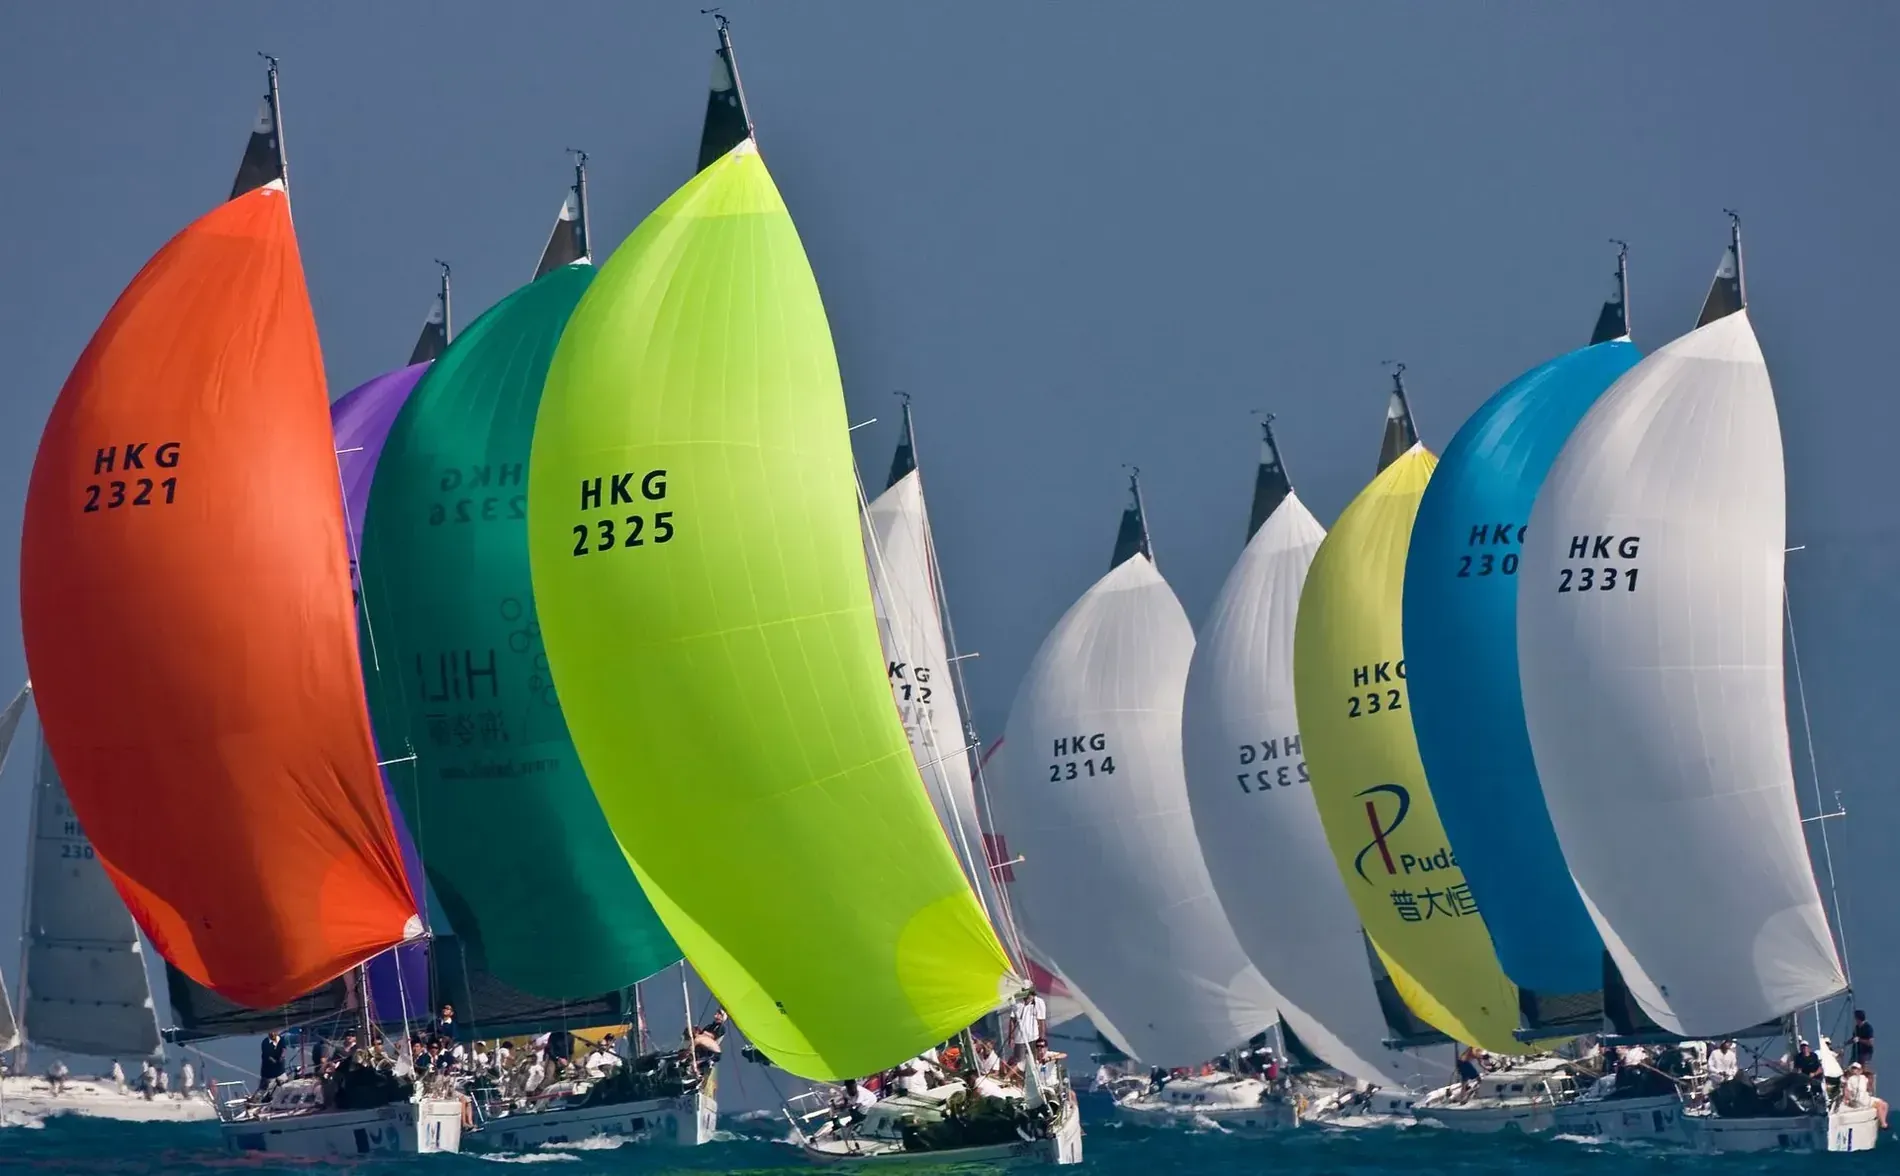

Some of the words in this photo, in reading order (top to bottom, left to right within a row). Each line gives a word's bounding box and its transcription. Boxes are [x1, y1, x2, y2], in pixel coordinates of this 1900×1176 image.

[94, 442, 181, 475] HKG
[83, 477, 177, 513] 2321
[581, 469, 667, 511] HKG
[572, 511, 675, 557] 2325
[1568, 536, 1641, 559] HKG
[1456, 553, 1519, 578] 230
[1558, 568, 1639, 593] 2331
[890, 683, 933, 704] 12
[1347, 689, 1402, 718] 232
[1053, 733, 1106, 757] HKG
[1049, 756, 1116, 783] 2314
